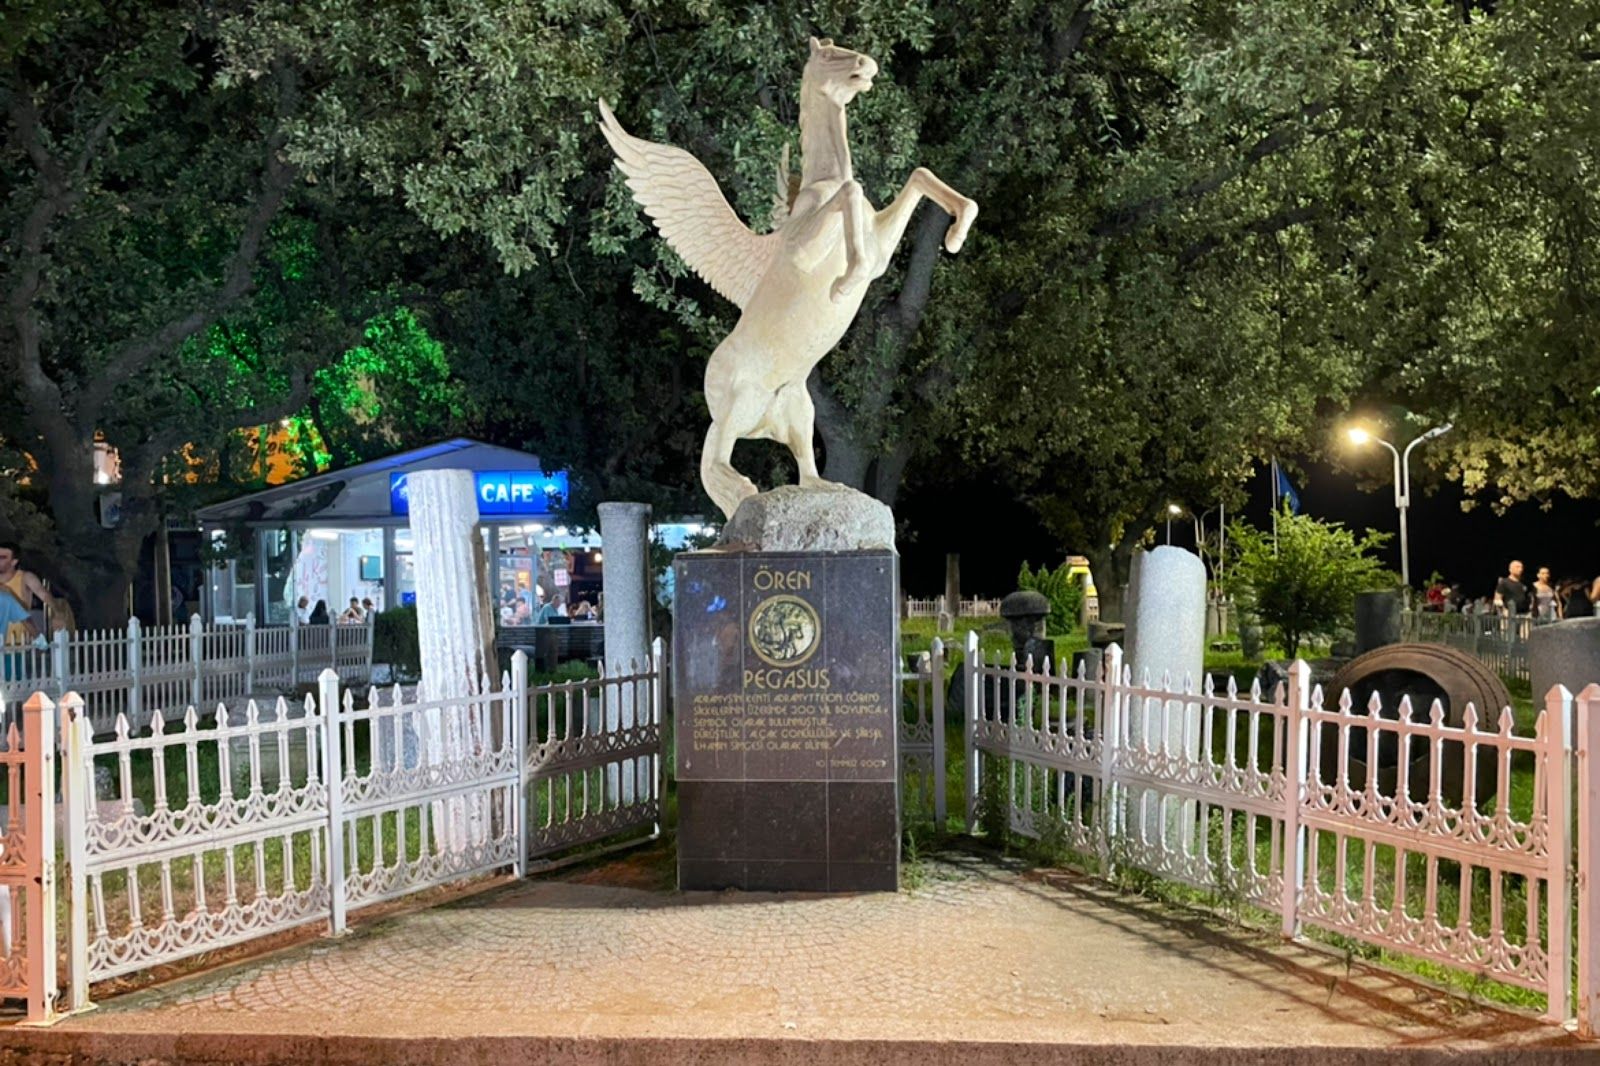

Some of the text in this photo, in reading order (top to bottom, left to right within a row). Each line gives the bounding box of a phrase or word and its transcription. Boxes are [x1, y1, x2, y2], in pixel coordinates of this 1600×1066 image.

[481, 483, 533, 503] CAFE
[753, 565, 811, 590] ÖREN
[743, 669, 830, 689] PEGASUS
[731, 717, 765, 727] OLARAK
